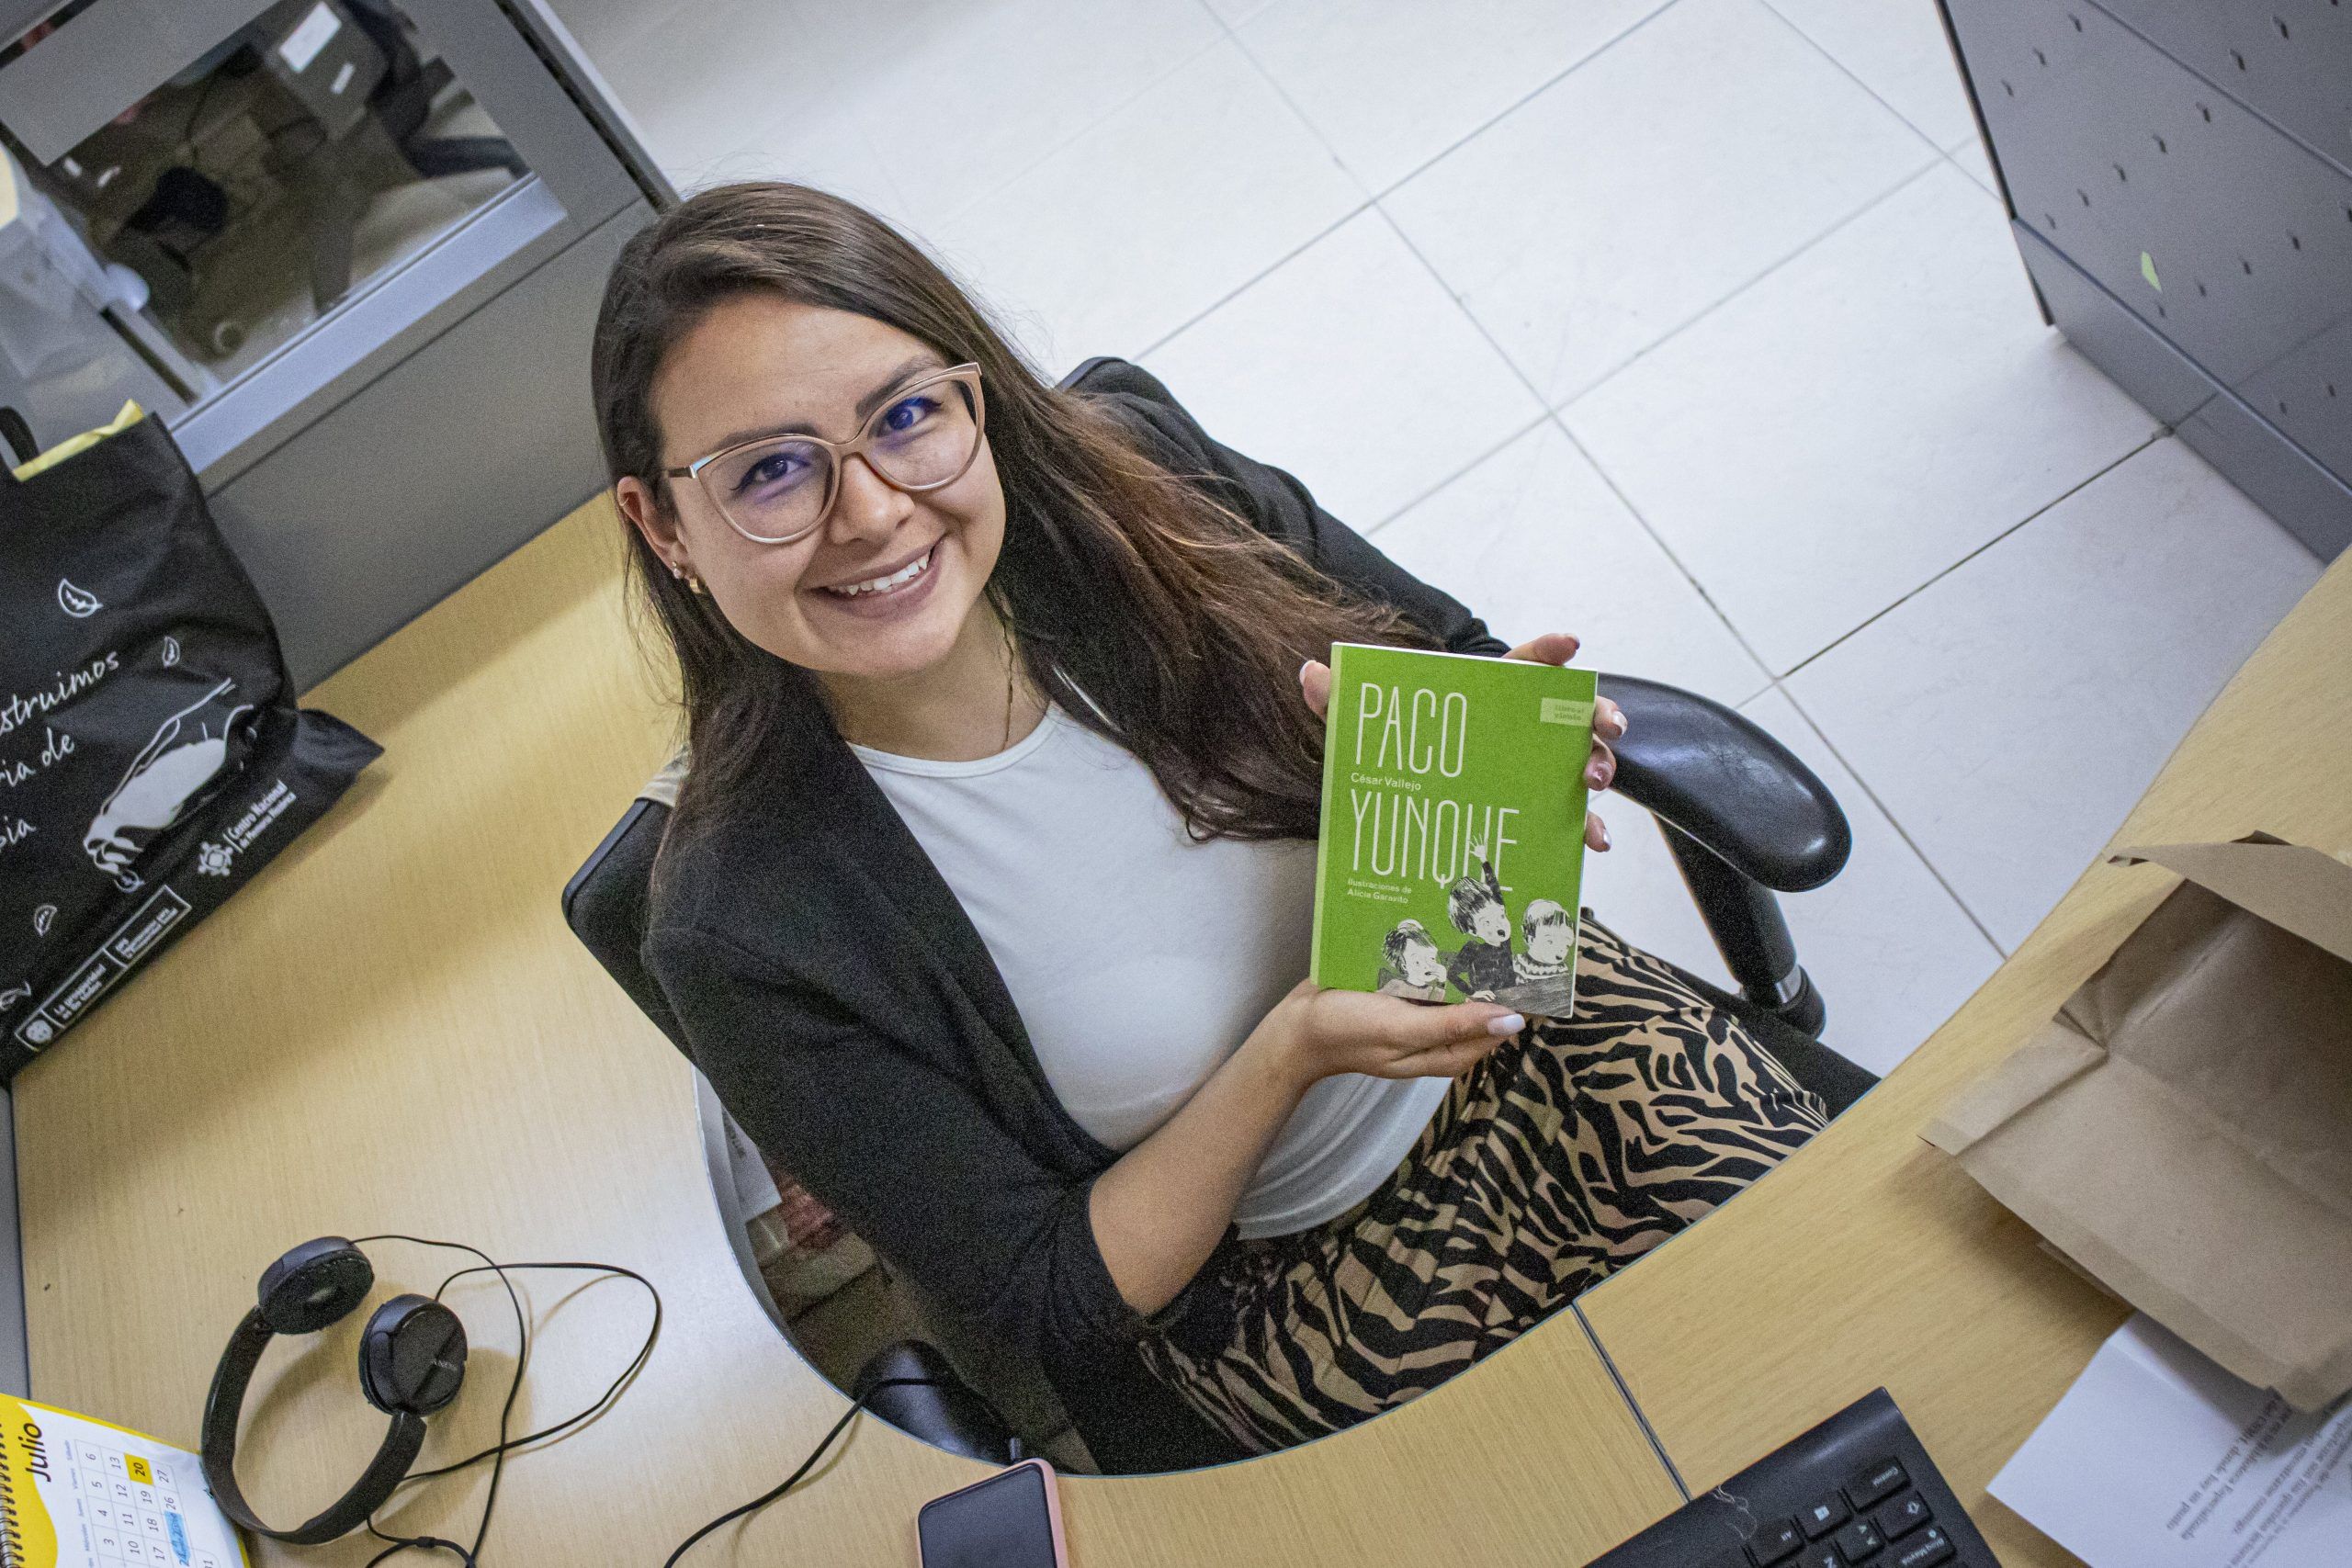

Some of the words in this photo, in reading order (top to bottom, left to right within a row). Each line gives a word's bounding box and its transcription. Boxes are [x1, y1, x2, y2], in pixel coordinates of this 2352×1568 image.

[1356, 682, 1467, 777] PACO
[42, 727, 75, 768] de
[1351, 772, 1383, 788] César
[1384, 775, 1422, 792] Vallejo
[1347, 888, 1372, 898] Alicia
[1374, 892, 1408, 904] Garavito
[1402, 886, 1412, 894] de
[17, 1423, 51, 1483] Julio
[109, 1456, 121, 1470] 13
[134, 1462, 146, 1477] 20
[156, 1470, 170, 1483] 27
[2199, 1472, 2218, 1493] hay
[92, 1481, 103, 1489] 5
[116, 1484, 128, 1498] 12
[141, 1491, 153, 1504] 19
[165, 1496, 176, 1510] 26
[2188, 1489, 2202, 1504] un
[97, 1509, 107, 1517] 4
[122, 1512, 134, 1526] 11
[2164, 1501, 2191, 1531] punto
[147, 1518, 159, 1533] 18
[104, 1538, 115, 1546] 3
[129, 1540, 141, 1554] 10
[153, 1547, 165, 1561] 17
